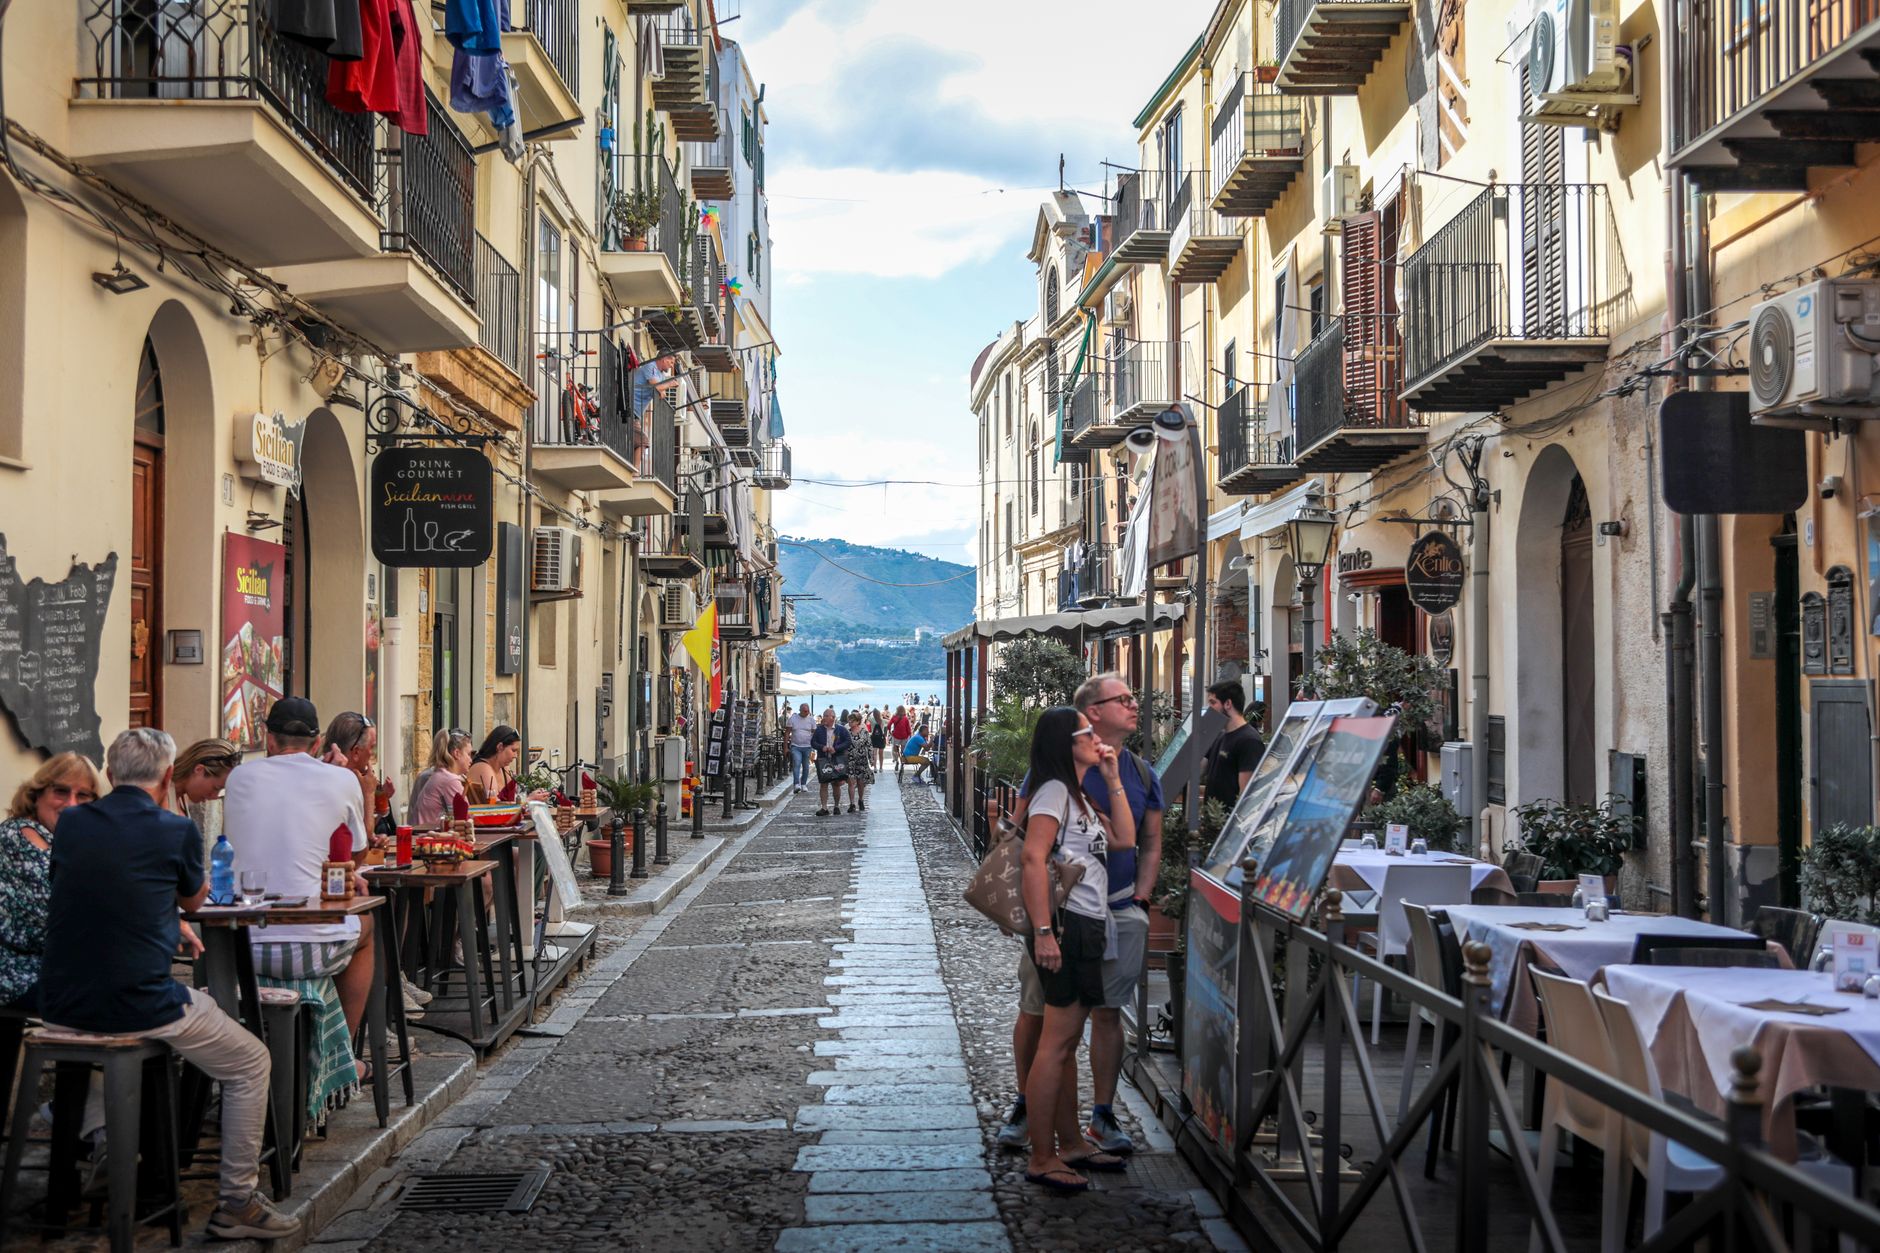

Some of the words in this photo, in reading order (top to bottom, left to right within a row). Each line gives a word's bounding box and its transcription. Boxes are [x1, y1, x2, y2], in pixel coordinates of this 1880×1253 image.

[255, 421, 295, 467] Sicilian
[409, 460, 452, 468] DRINK
[397, 470, 463, 479] GOURMET
[236, 567, 267, 596] Sicilian
